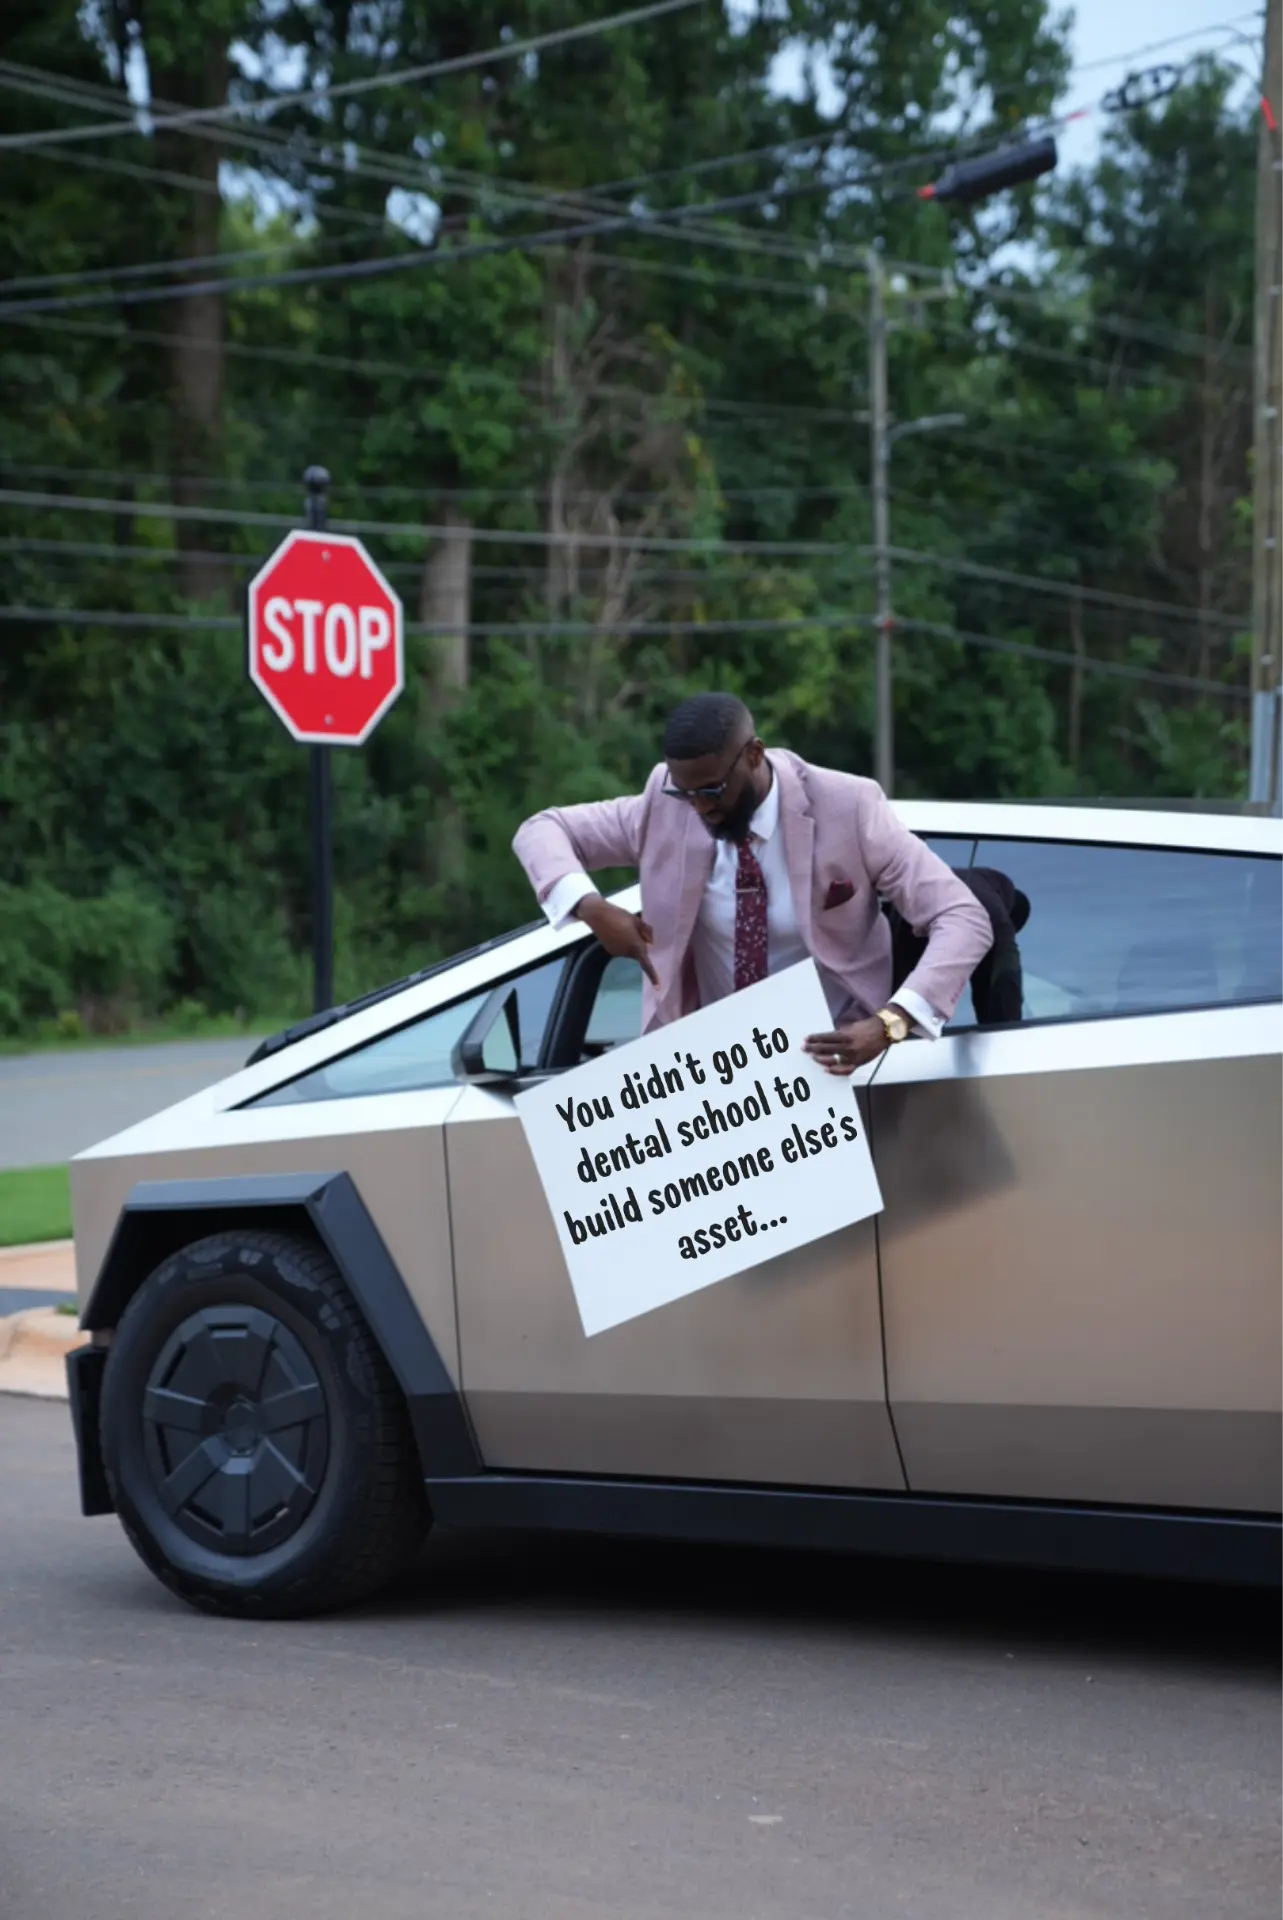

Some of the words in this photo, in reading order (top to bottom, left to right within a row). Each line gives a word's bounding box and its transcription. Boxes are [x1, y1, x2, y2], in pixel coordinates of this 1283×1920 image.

[262, 596, 391, 679] STOP
[555, 1096, 614, 1132] You
[620, 1052, 706, 1109] didn't
[713, 1044, 748, 1084] go
[752, 1028, 789, 1059] to
[577, 1119, 672, 1183] dental
[677, 1080, 772, 1147] school
[774, 1077, 811, 1108] to
[564, 1187, 643, 1245] build
[648, 1148, 774, 1215] someone
[781, 1107, 858, 1163] else's
[678, 1205, 788, 1260] asset...
